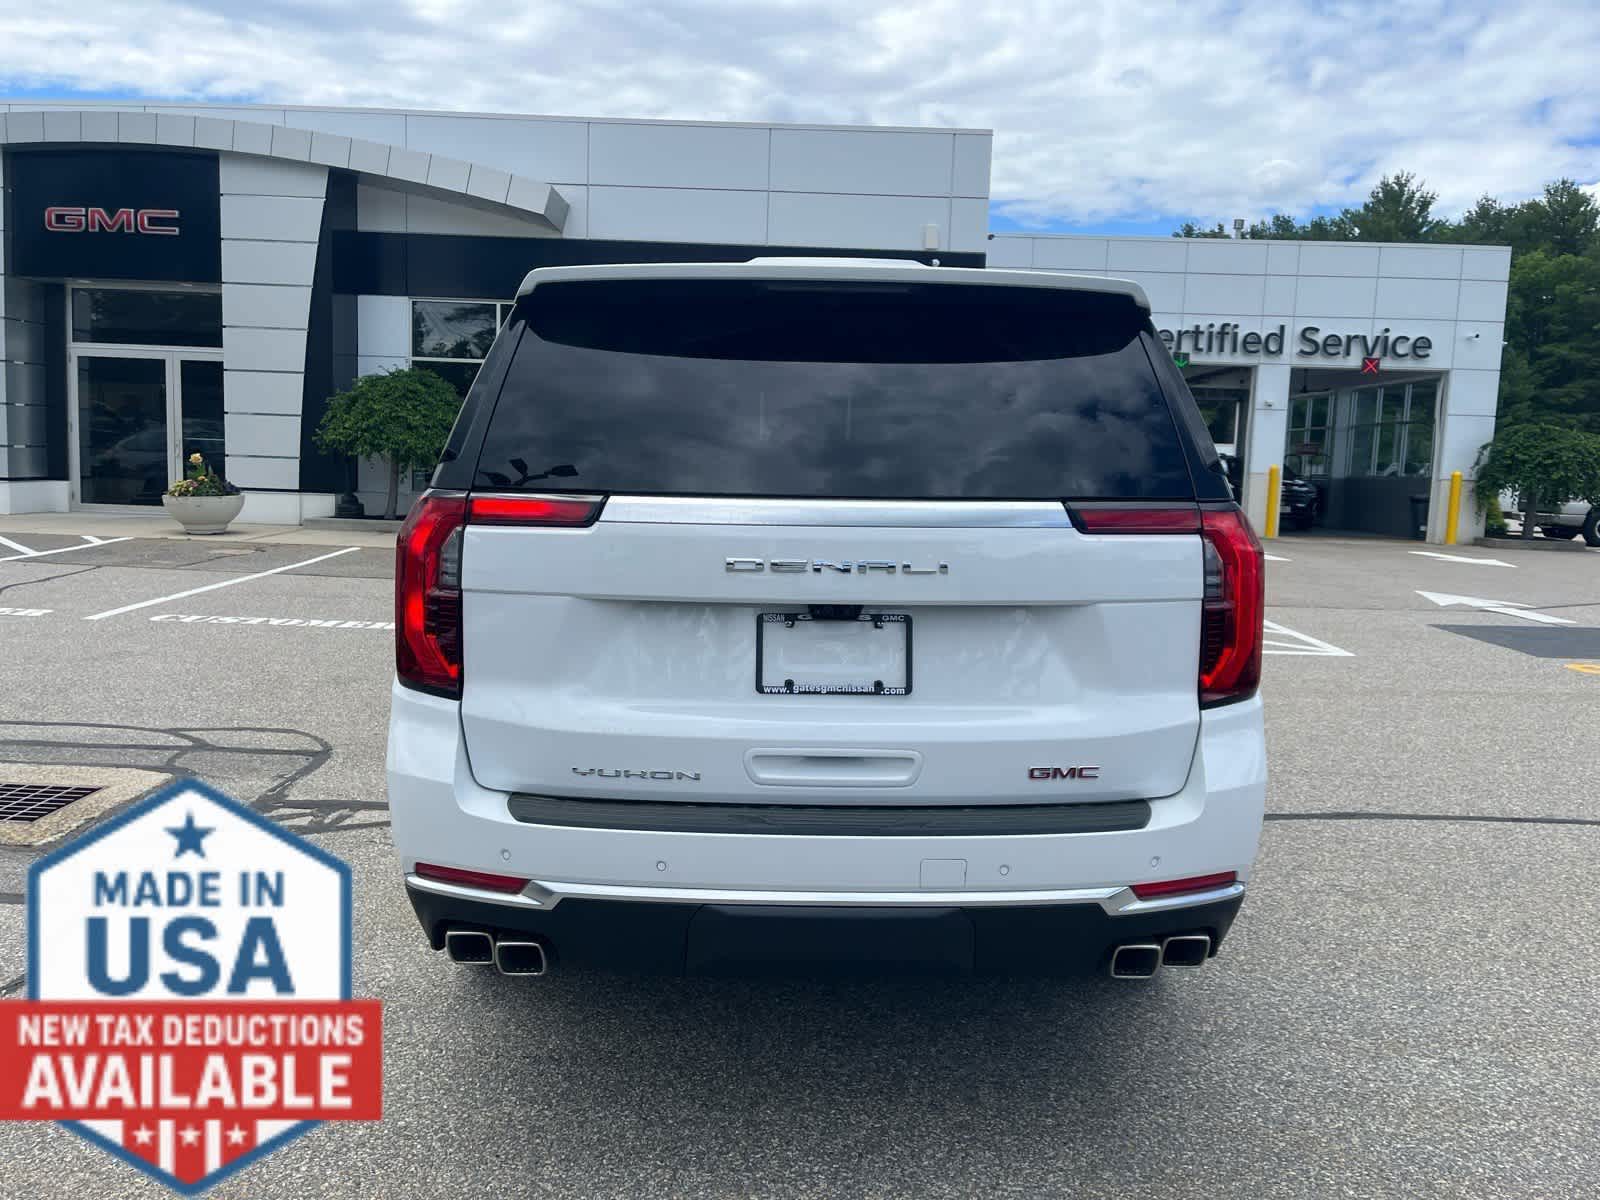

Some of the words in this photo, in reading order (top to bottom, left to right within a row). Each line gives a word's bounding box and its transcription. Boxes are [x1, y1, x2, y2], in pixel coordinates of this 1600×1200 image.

[45, 207, 180, 235] GMC
[1158, 323, 1287, 355] ertified
[1297, 326, 1433, 359] Service
[725, 557, 949, 575] DENALI
[572, 767, 701, 780] YUKON
[1028, 766, 1101, 780] GMC
